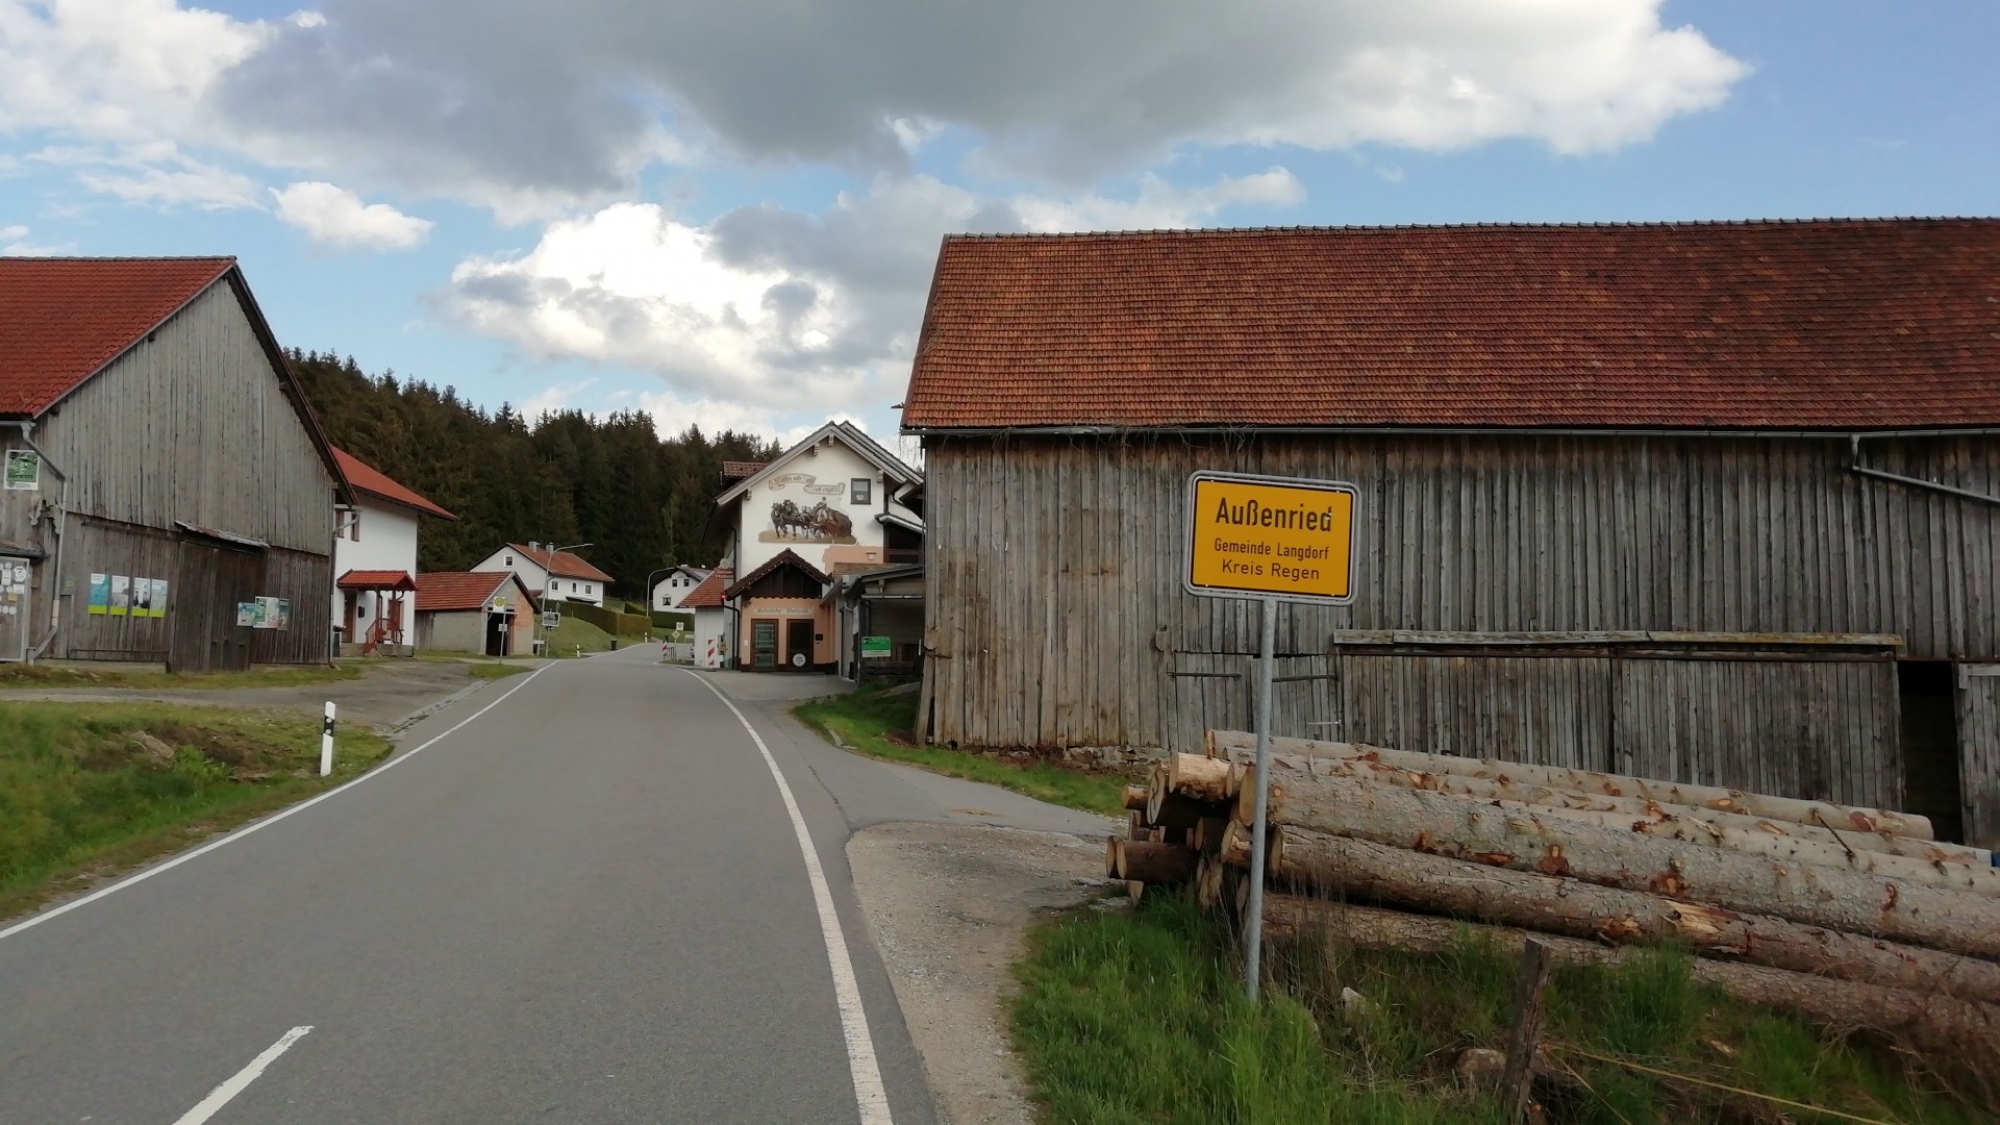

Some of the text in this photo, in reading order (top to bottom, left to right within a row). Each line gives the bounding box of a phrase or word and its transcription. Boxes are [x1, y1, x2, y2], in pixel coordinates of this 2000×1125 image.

[1215, 497, 1332, 532] Außenried
[1214, 537, 1330, 561] Gemeinde Langdorf
[1222, 559, 1320, 582] Kreis Regen
